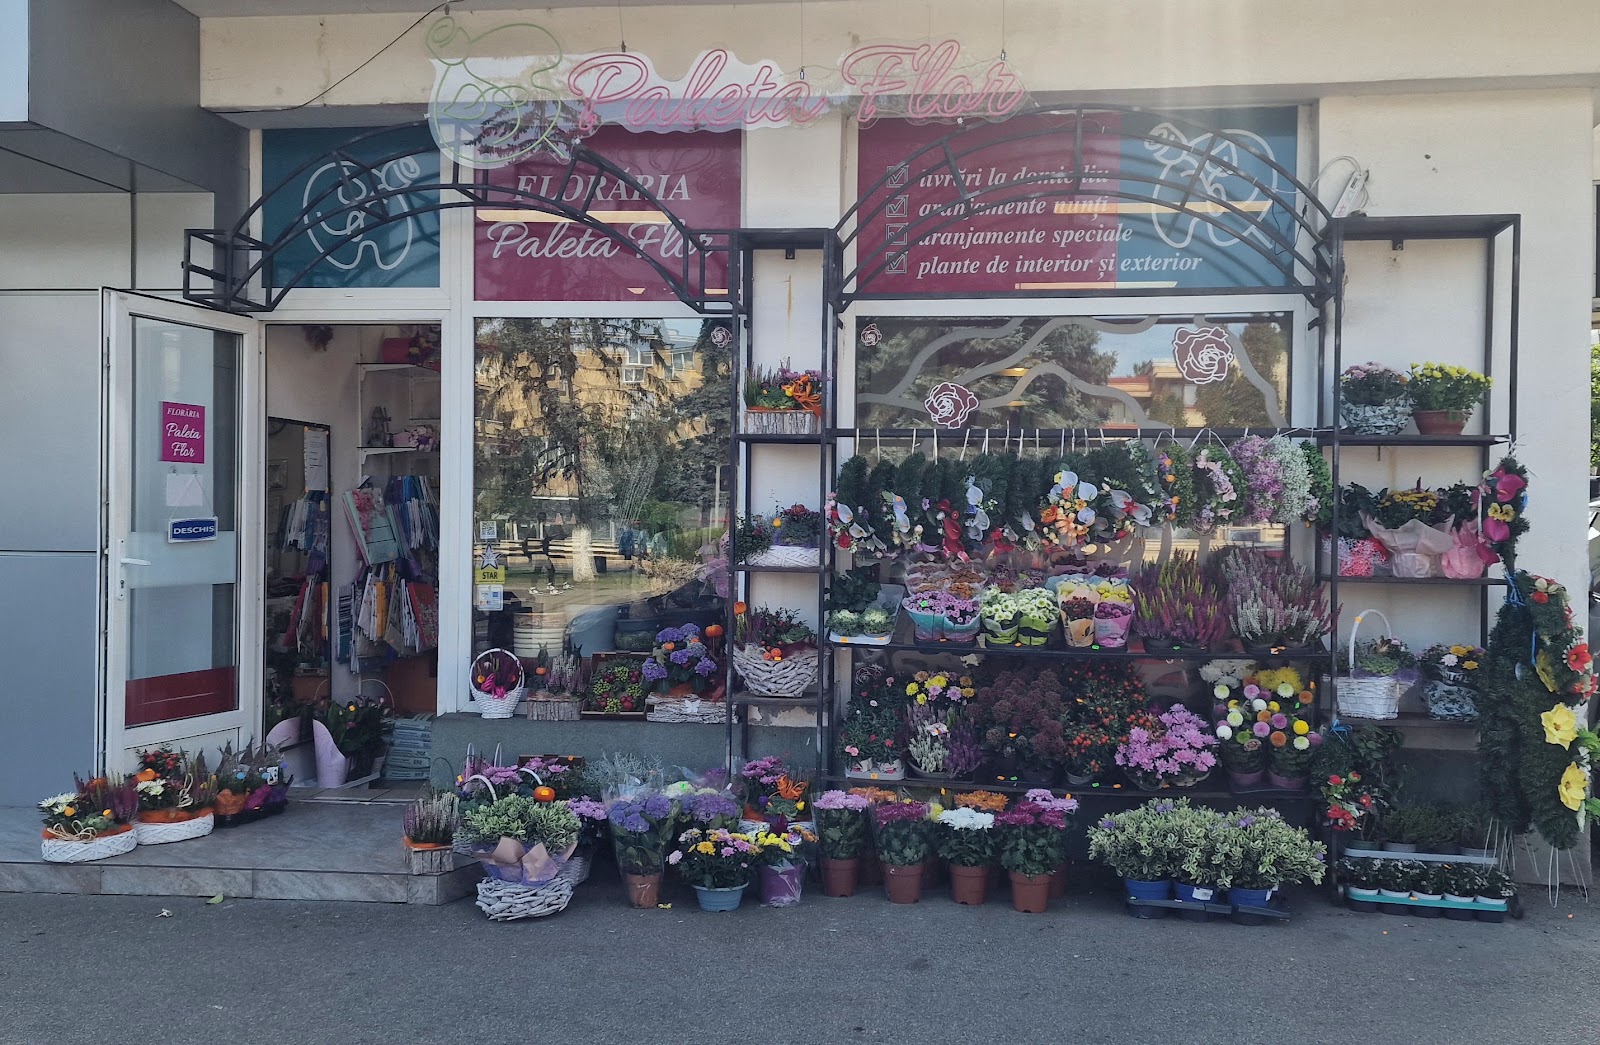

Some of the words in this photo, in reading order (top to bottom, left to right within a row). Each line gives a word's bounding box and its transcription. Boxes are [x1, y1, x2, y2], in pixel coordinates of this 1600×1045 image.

[568, 49, 828, 130] Paleta
[842, 40, 1023, 121] Flor
[988, 167, 1007, 186] la
[486, 221, 621, 259] Paleta
[919, 226, 1046, 249] aranjamente
[1052, 223, 1133, 248] speciale
[916, 256, 980, 279] plante
[986, 255, 1009, 274] de
[1015, 254, 1094, 273] interior
[1097, 253, 1117, 280] și
[1120, 252, 1203, 272] exterior
[166, 407, 200, 418] FLORĂRIA
[165, 422, 202, 440] Paleta
[171, 441, 195, 457] Flor
[173, 524, 215, 535] DESCHIS
[482, 571, 499, 580] STAR
